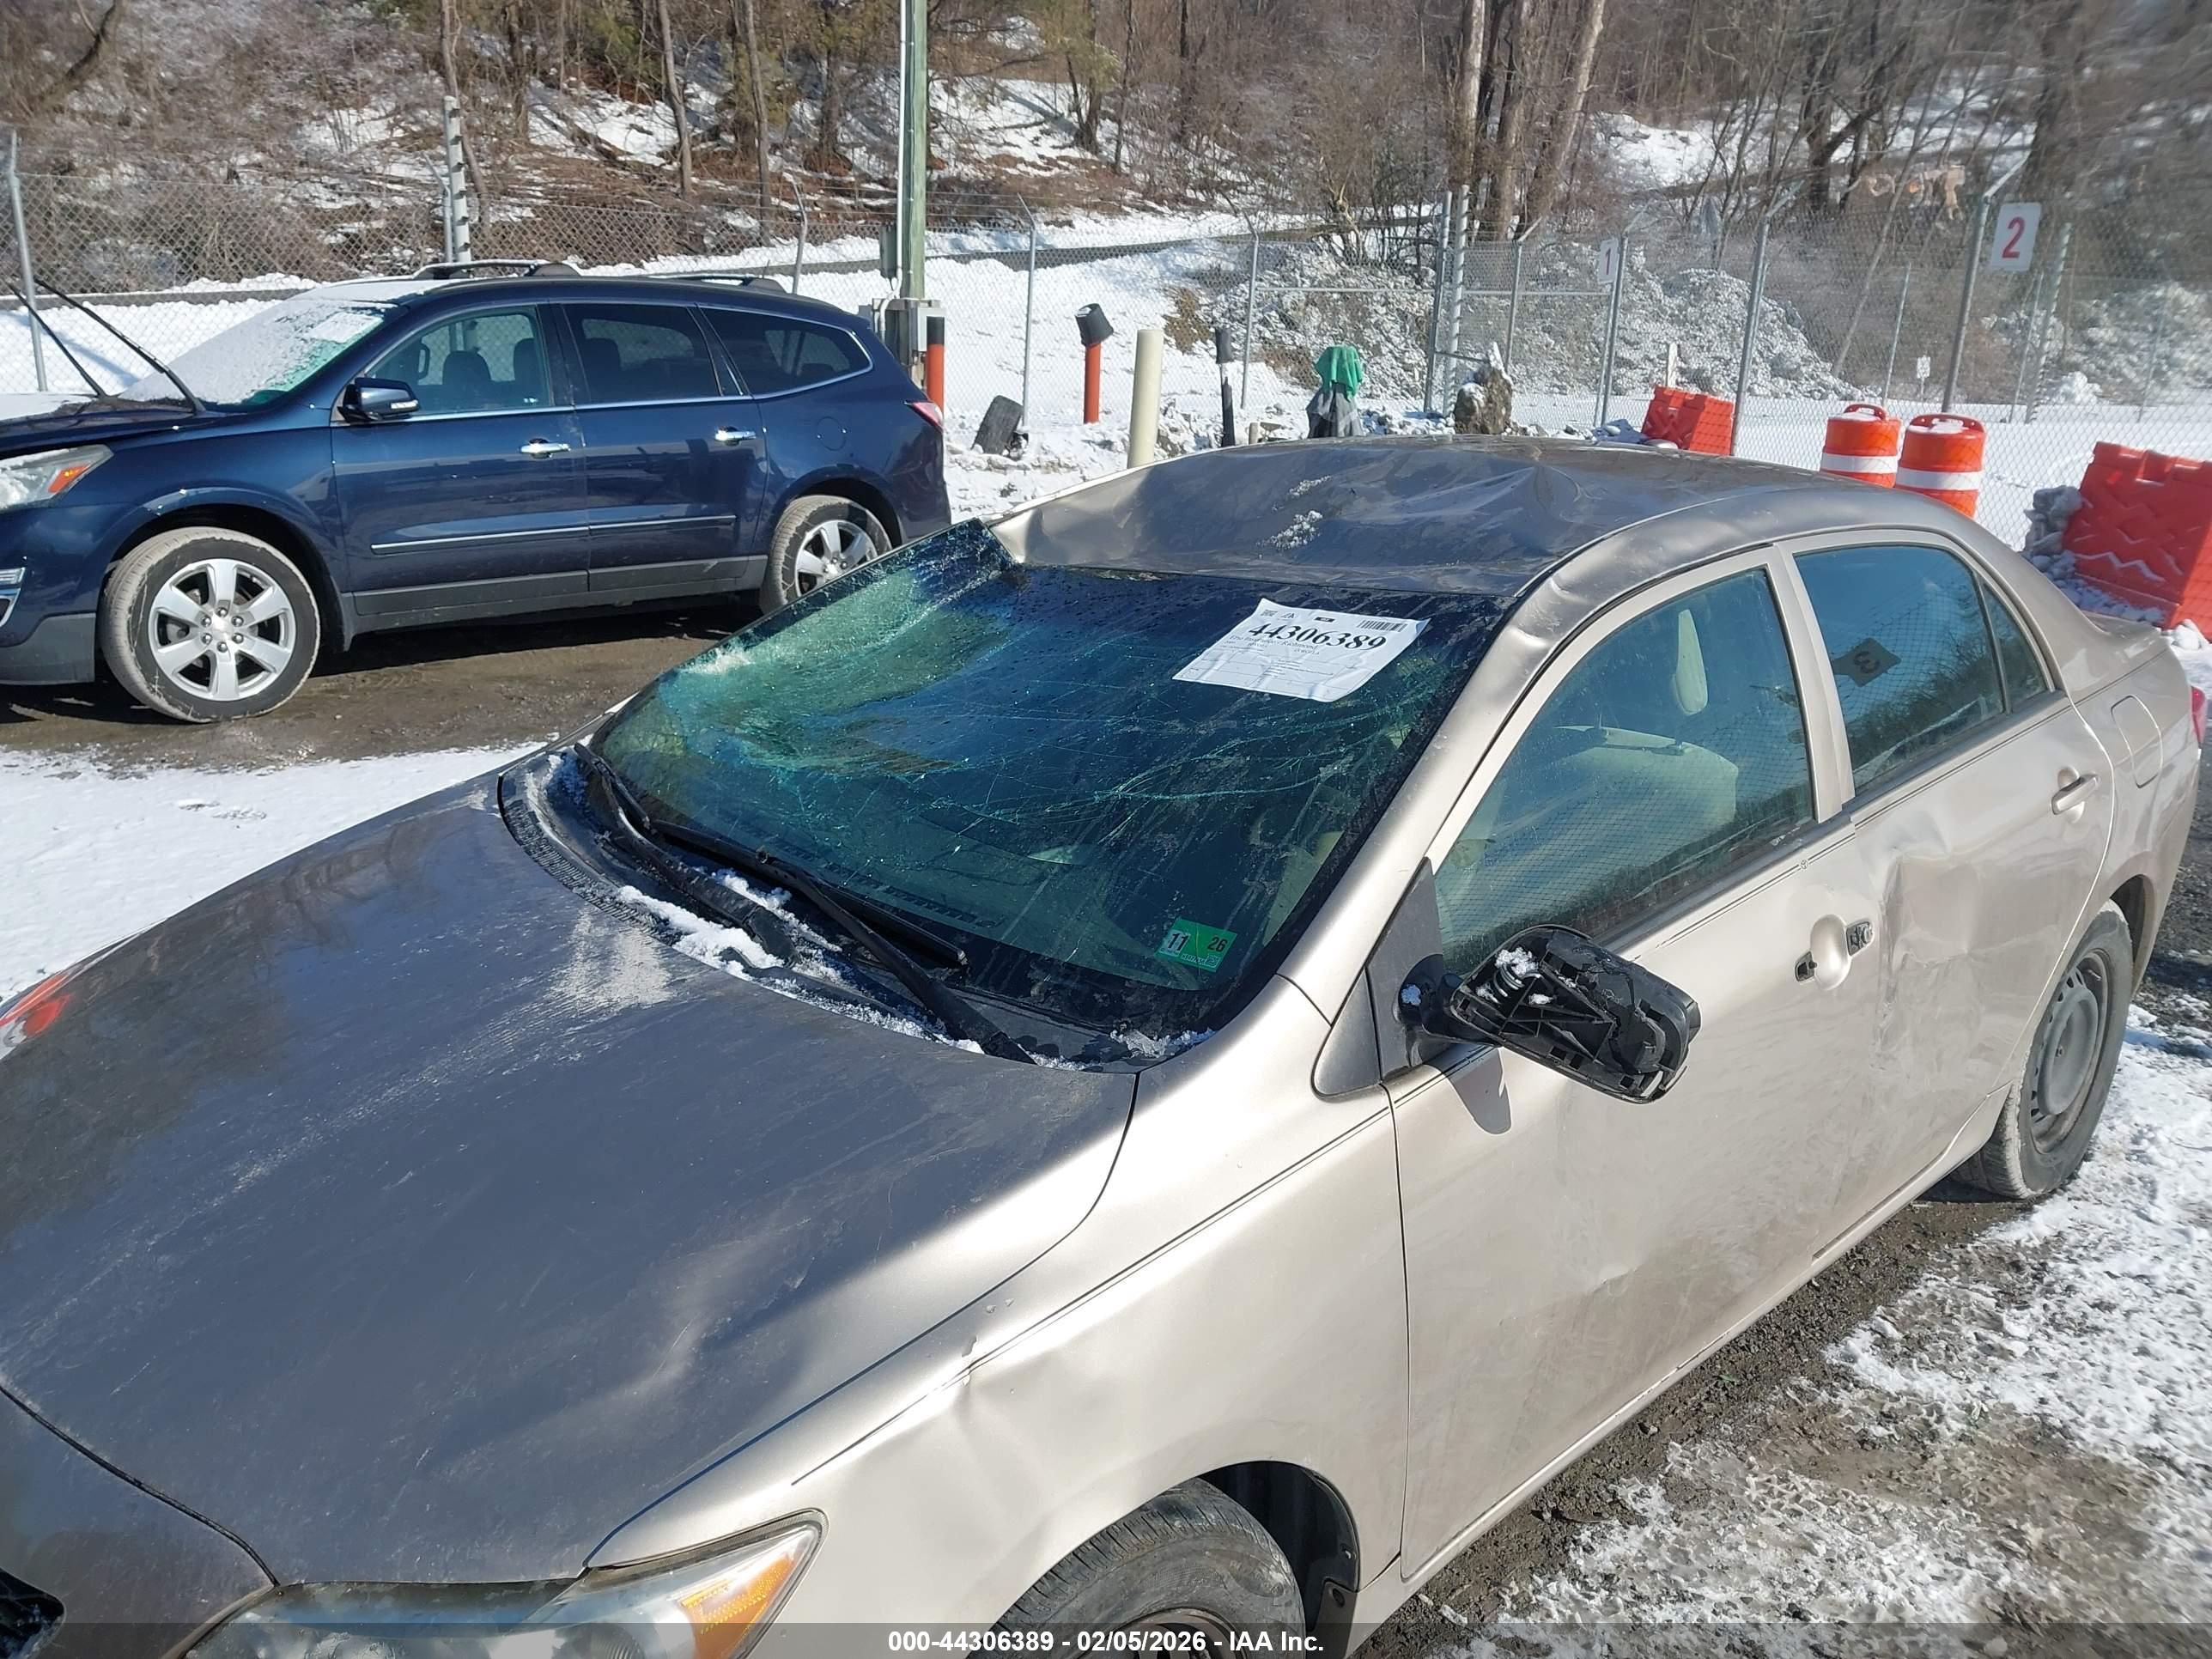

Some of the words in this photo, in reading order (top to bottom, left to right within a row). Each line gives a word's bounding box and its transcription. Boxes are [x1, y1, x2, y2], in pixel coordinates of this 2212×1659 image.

[2002, 216, 2026, 258] 2
[1605, 247, 1612, 275] 1
[1249, 623, 1387, 651] 44306389
[1168, 933, 1188, 951] 11
[1207, 936, 1228, 952] 26
